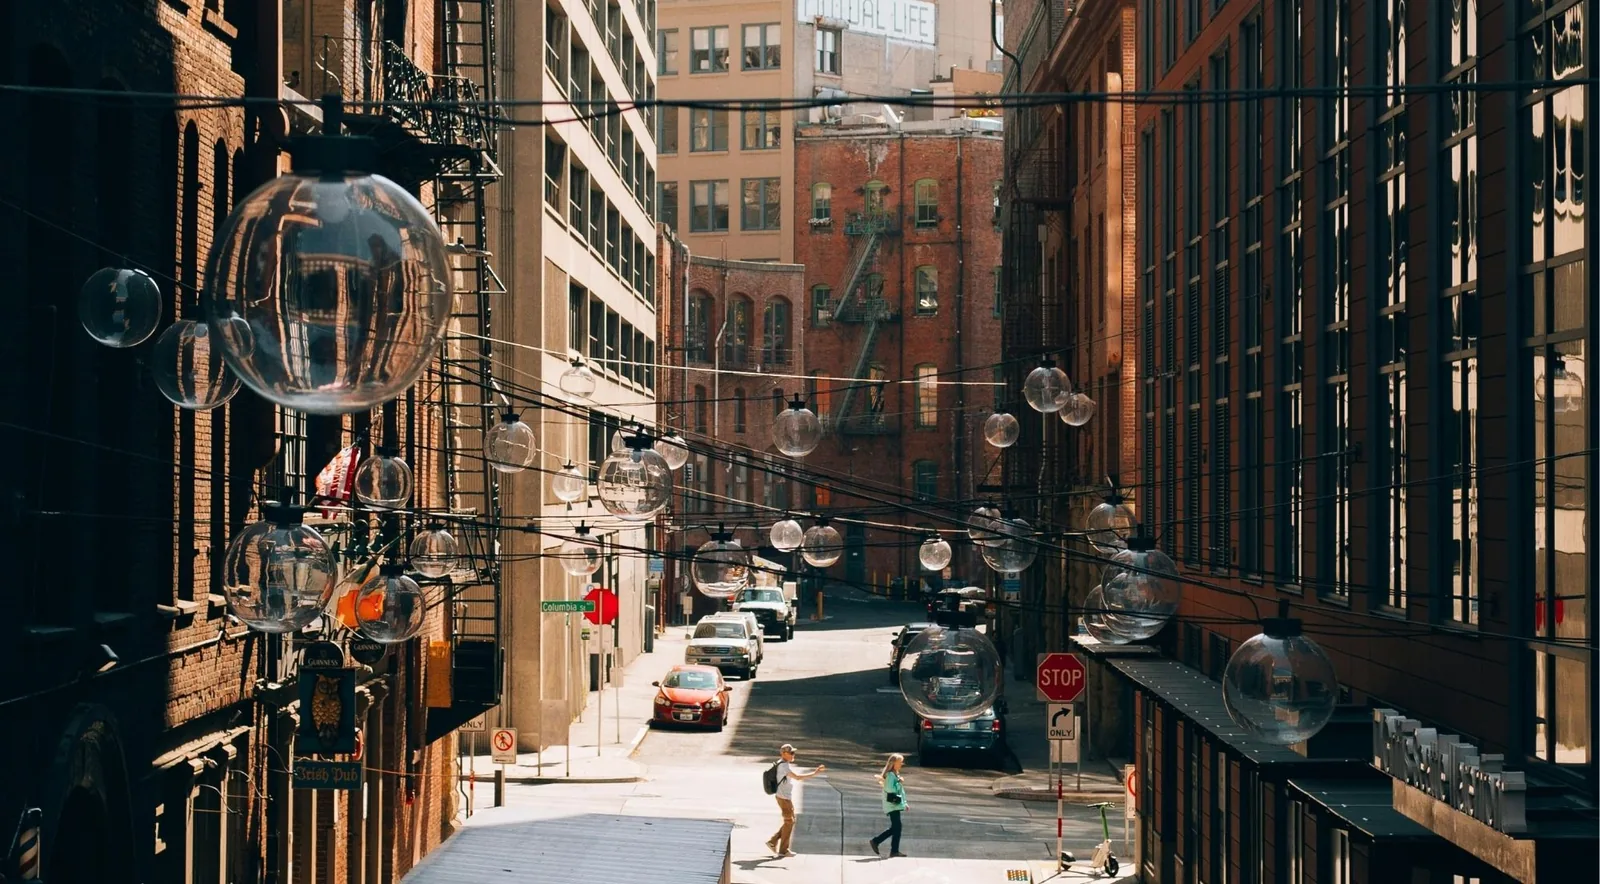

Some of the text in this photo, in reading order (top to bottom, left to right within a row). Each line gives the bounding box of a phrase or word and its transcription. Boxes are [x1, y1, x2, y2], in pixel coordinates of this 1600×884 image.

[894, 2, 929, 37] LIFE
[543, 602, 577, 611] Columbia
[308, 658, 339, 666] GUINNESS
[1041, 668, 1082, 686] STOP
[1050, 729, 1072, 737] ONLY
[296, 767, 358, 783] Irish Pub
